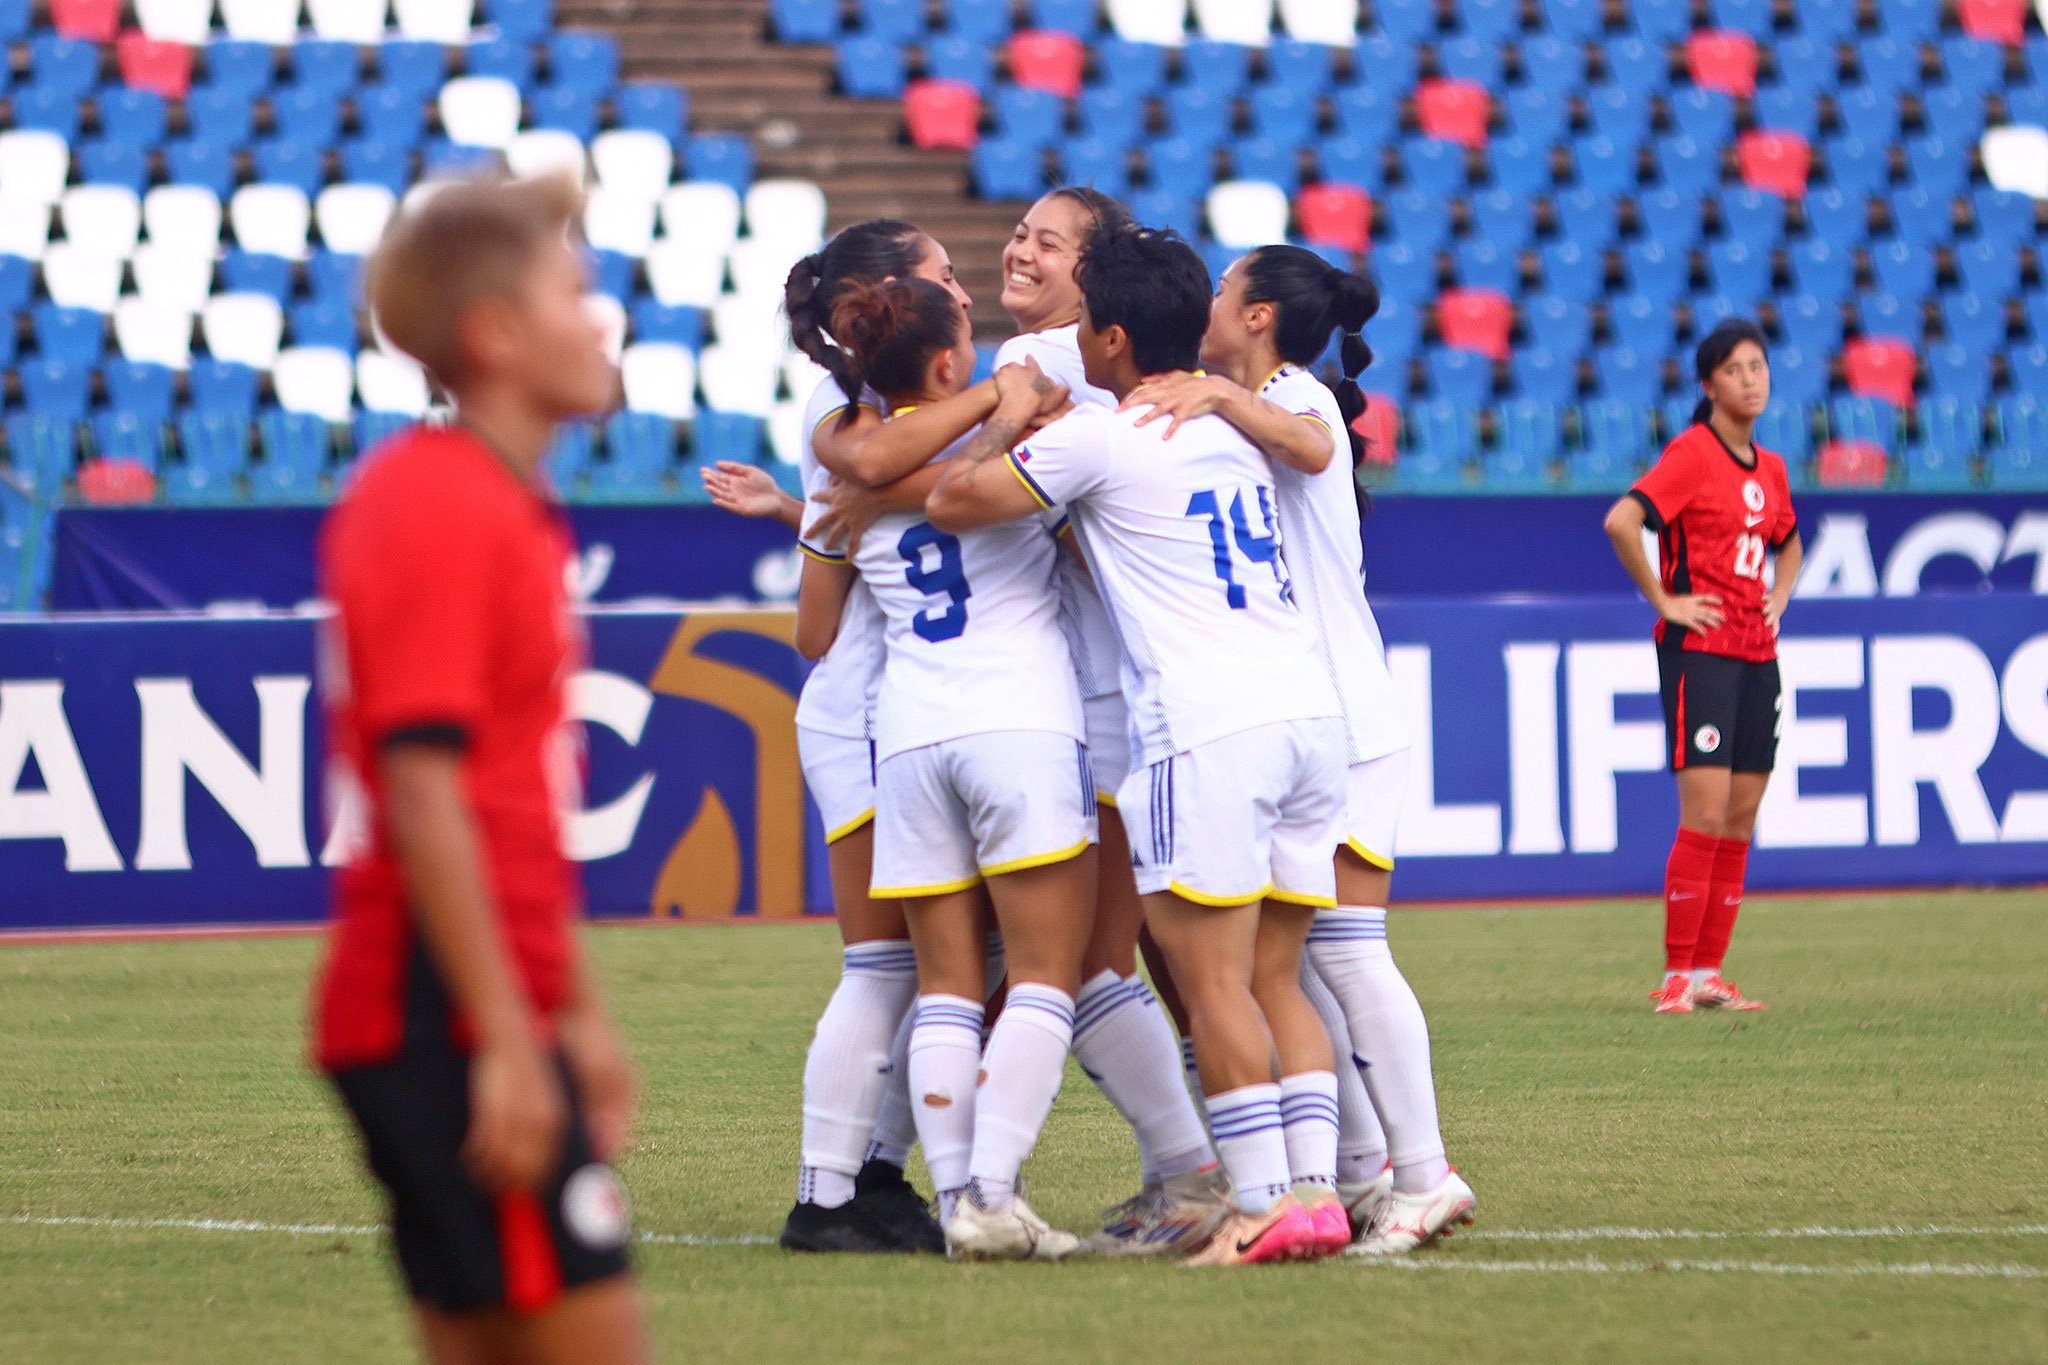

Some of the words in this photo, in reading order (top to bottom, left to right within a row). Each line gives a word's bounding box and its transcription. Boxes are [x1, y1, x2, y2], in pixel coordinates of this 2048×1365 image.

[897, 521, 973, 643] 9
[1185, 485, 1293, 610] 14
[1386, 630, 2048, 857] LIFER
